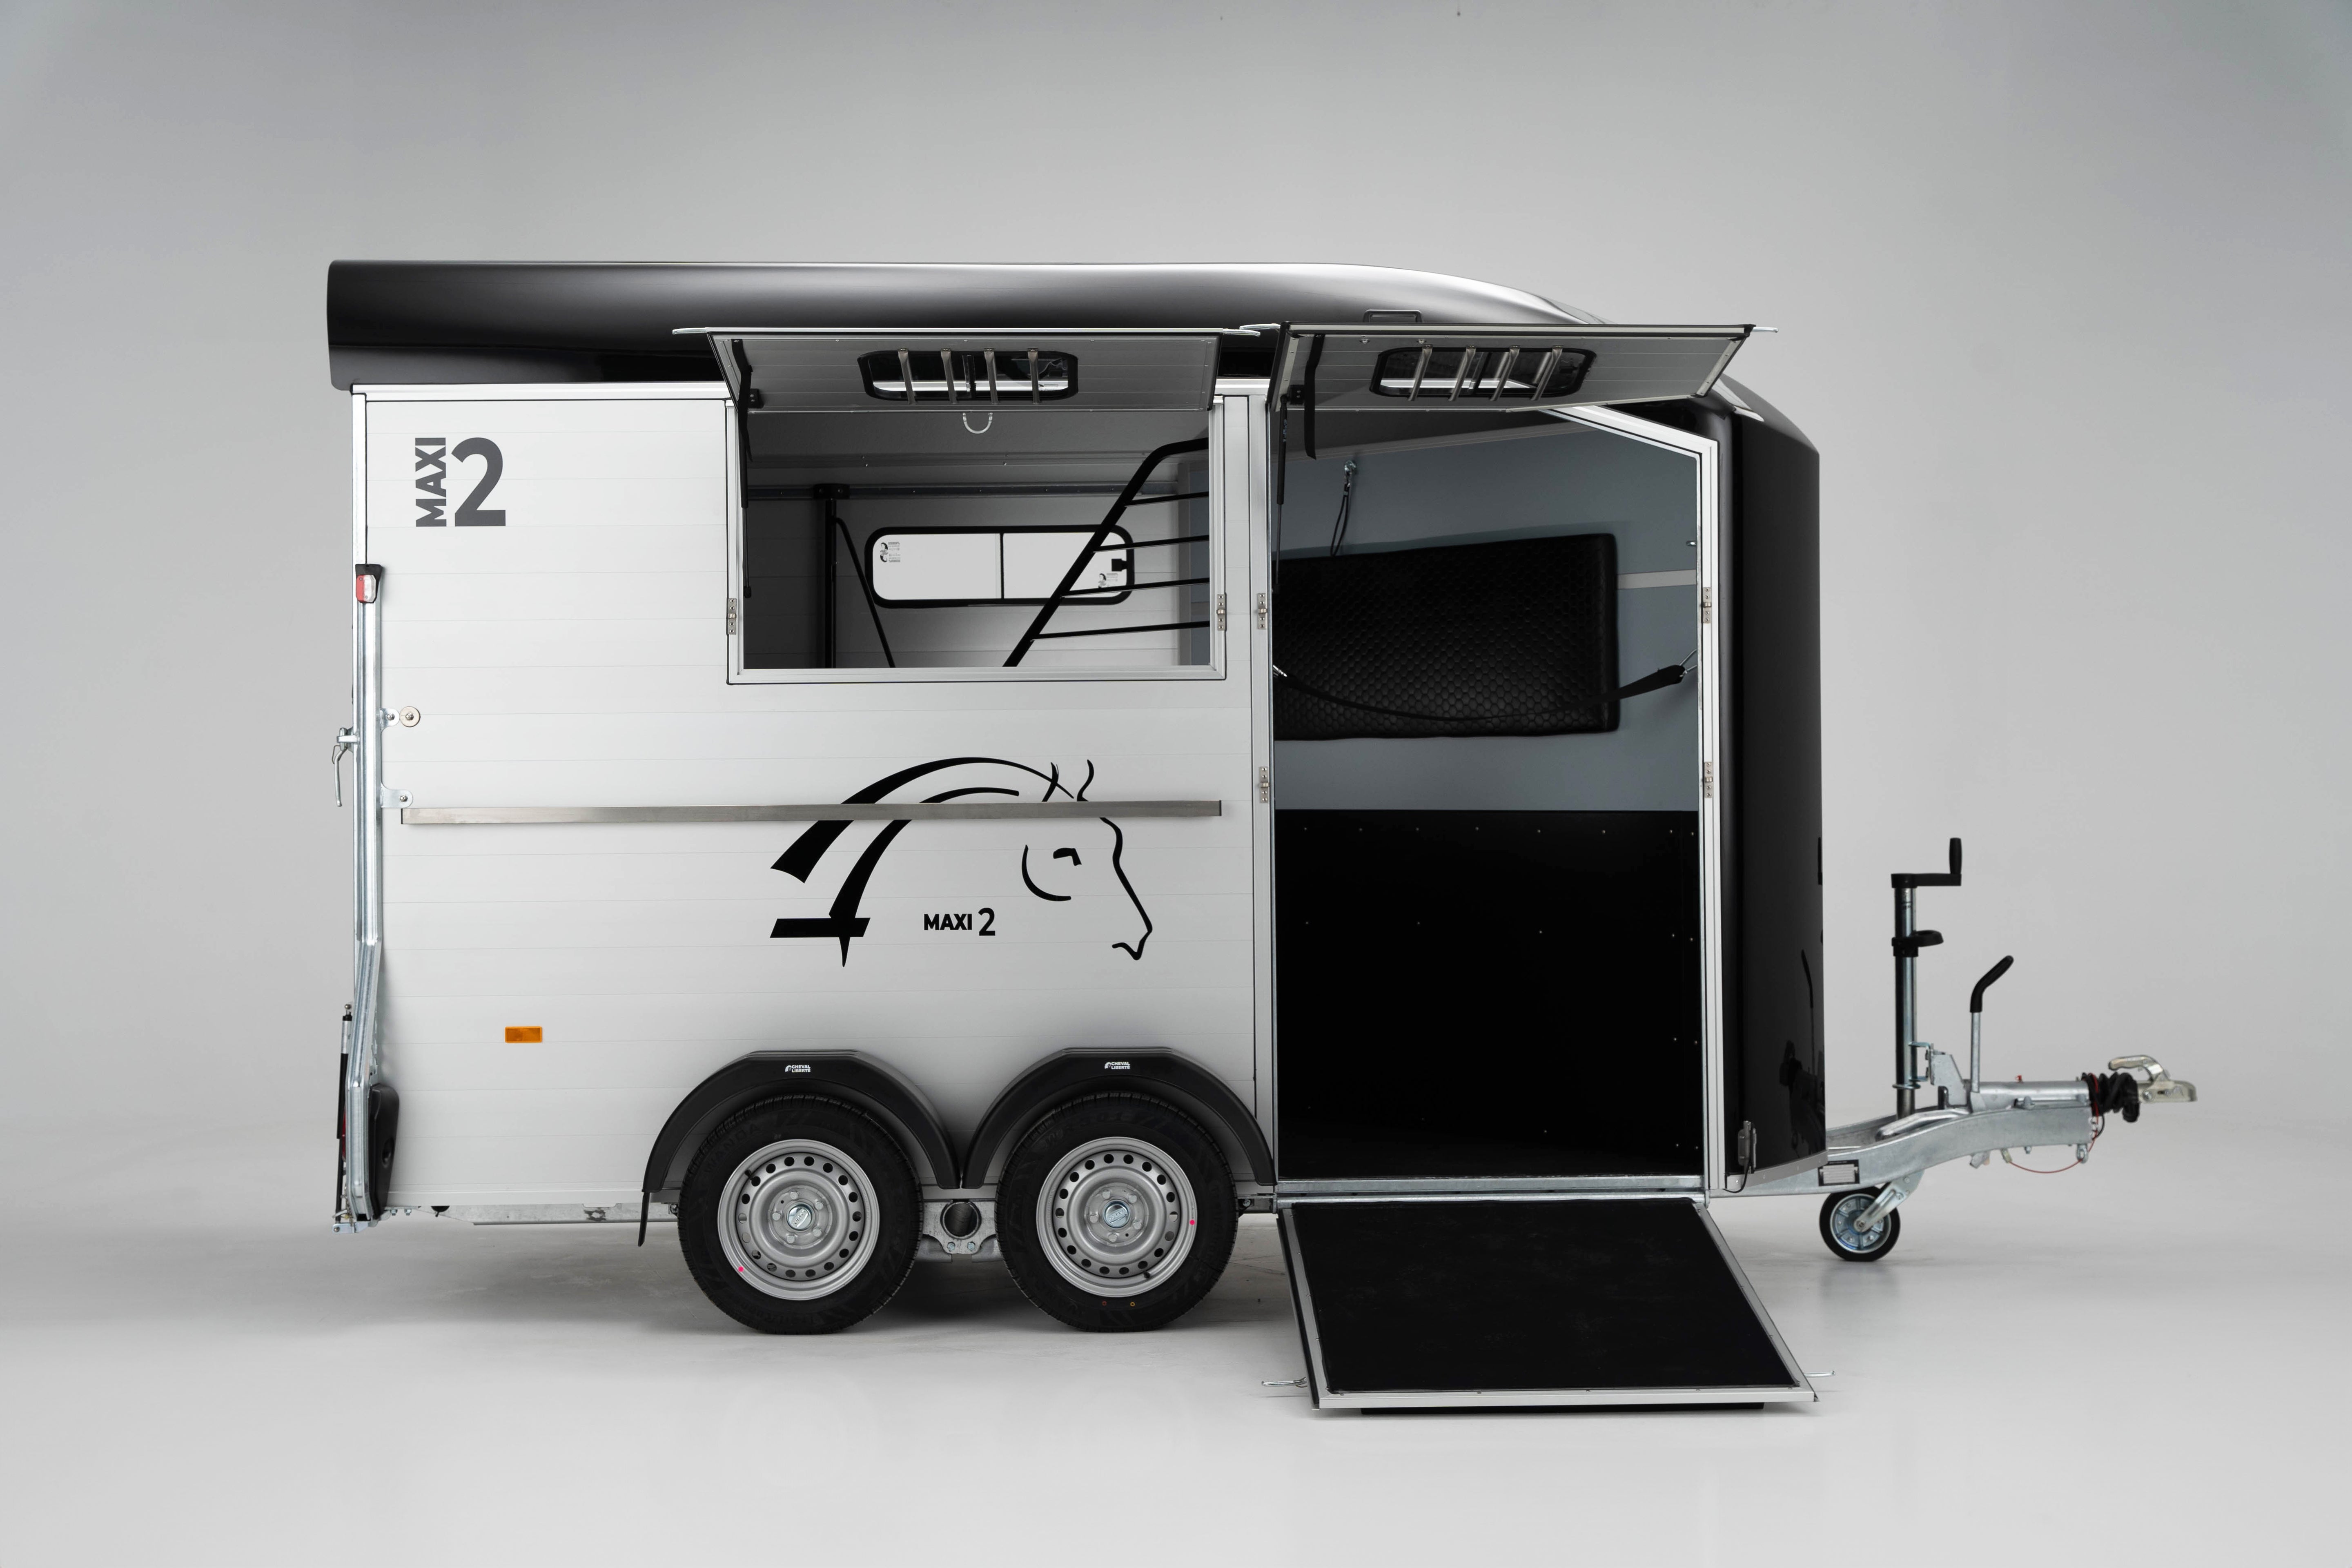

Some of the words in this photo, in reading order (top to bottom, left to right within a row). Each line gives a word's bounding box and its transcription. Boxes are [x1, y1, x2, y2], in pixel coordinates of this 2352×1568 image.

[415, 437, 447, 527] MAXI
[451, 437, 506, 527] 2
[924, 913, 972, 931] MAXI
[978, 907, 996, 936] 2
